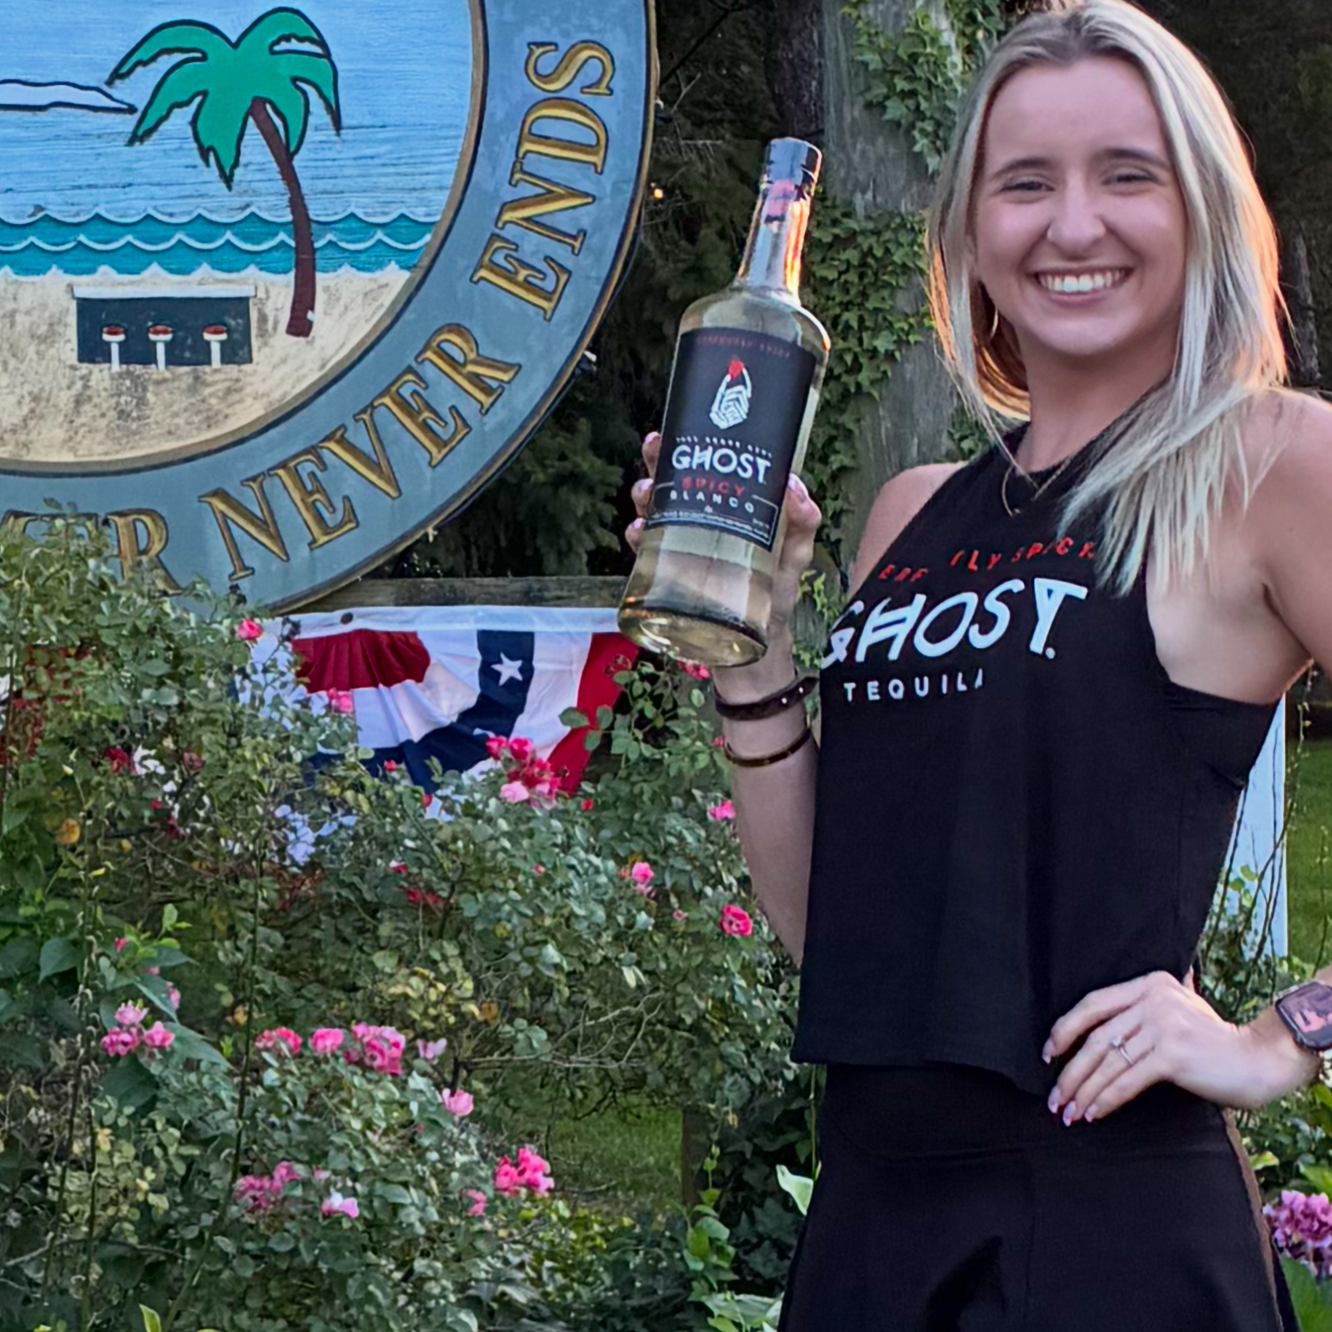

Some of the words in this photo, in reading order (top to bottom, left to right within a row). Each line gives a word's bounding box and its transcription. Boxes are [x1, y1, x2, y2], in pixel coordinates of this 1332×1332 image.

[197, 322, 523, 583] NEVER
[471, 39, 616, 322] ENDS
[671, 444, 772, 484] GHOST
[669, 489, 756, 514] BLANCO
